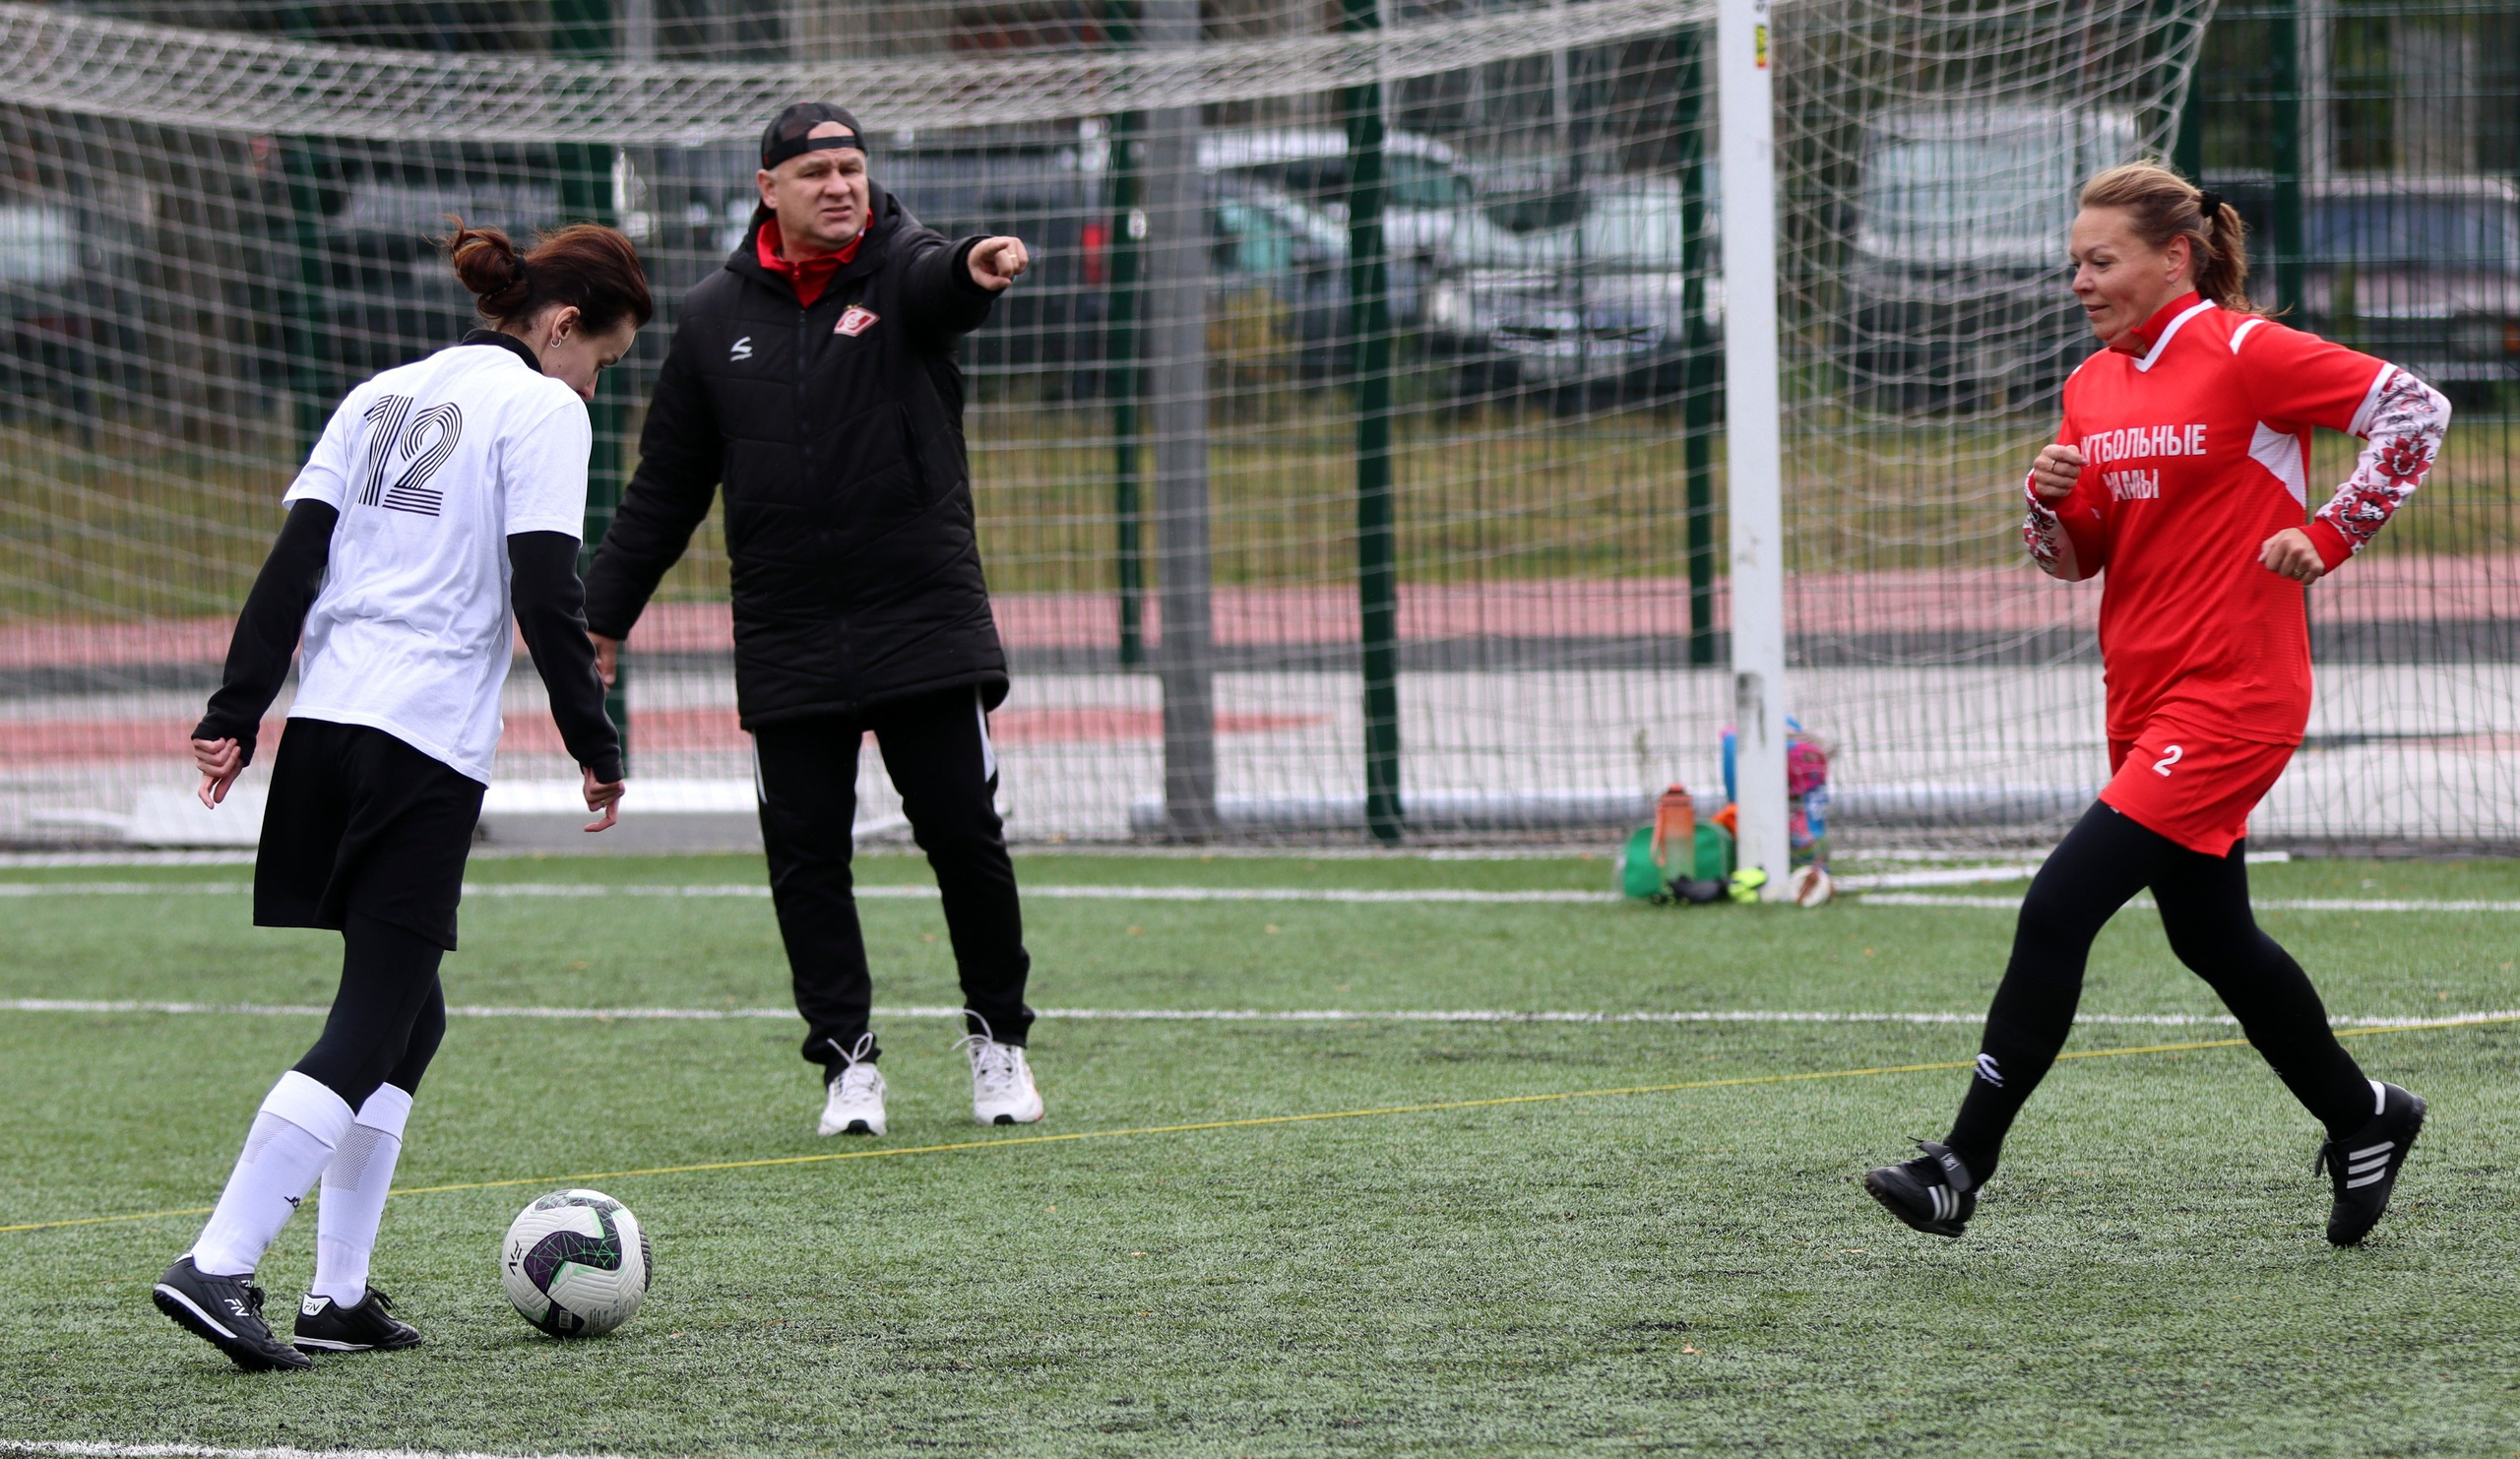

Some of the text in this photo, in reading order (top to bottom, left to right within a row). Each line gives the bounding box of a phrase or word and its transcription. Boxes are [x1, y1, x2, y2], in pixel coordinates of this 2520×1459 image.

[355, 394, 463, 517] 12
[2080, 423, 2208, 467] УТБОЛЬНЫЕ
[2151, 744, 2183, 778] 2
